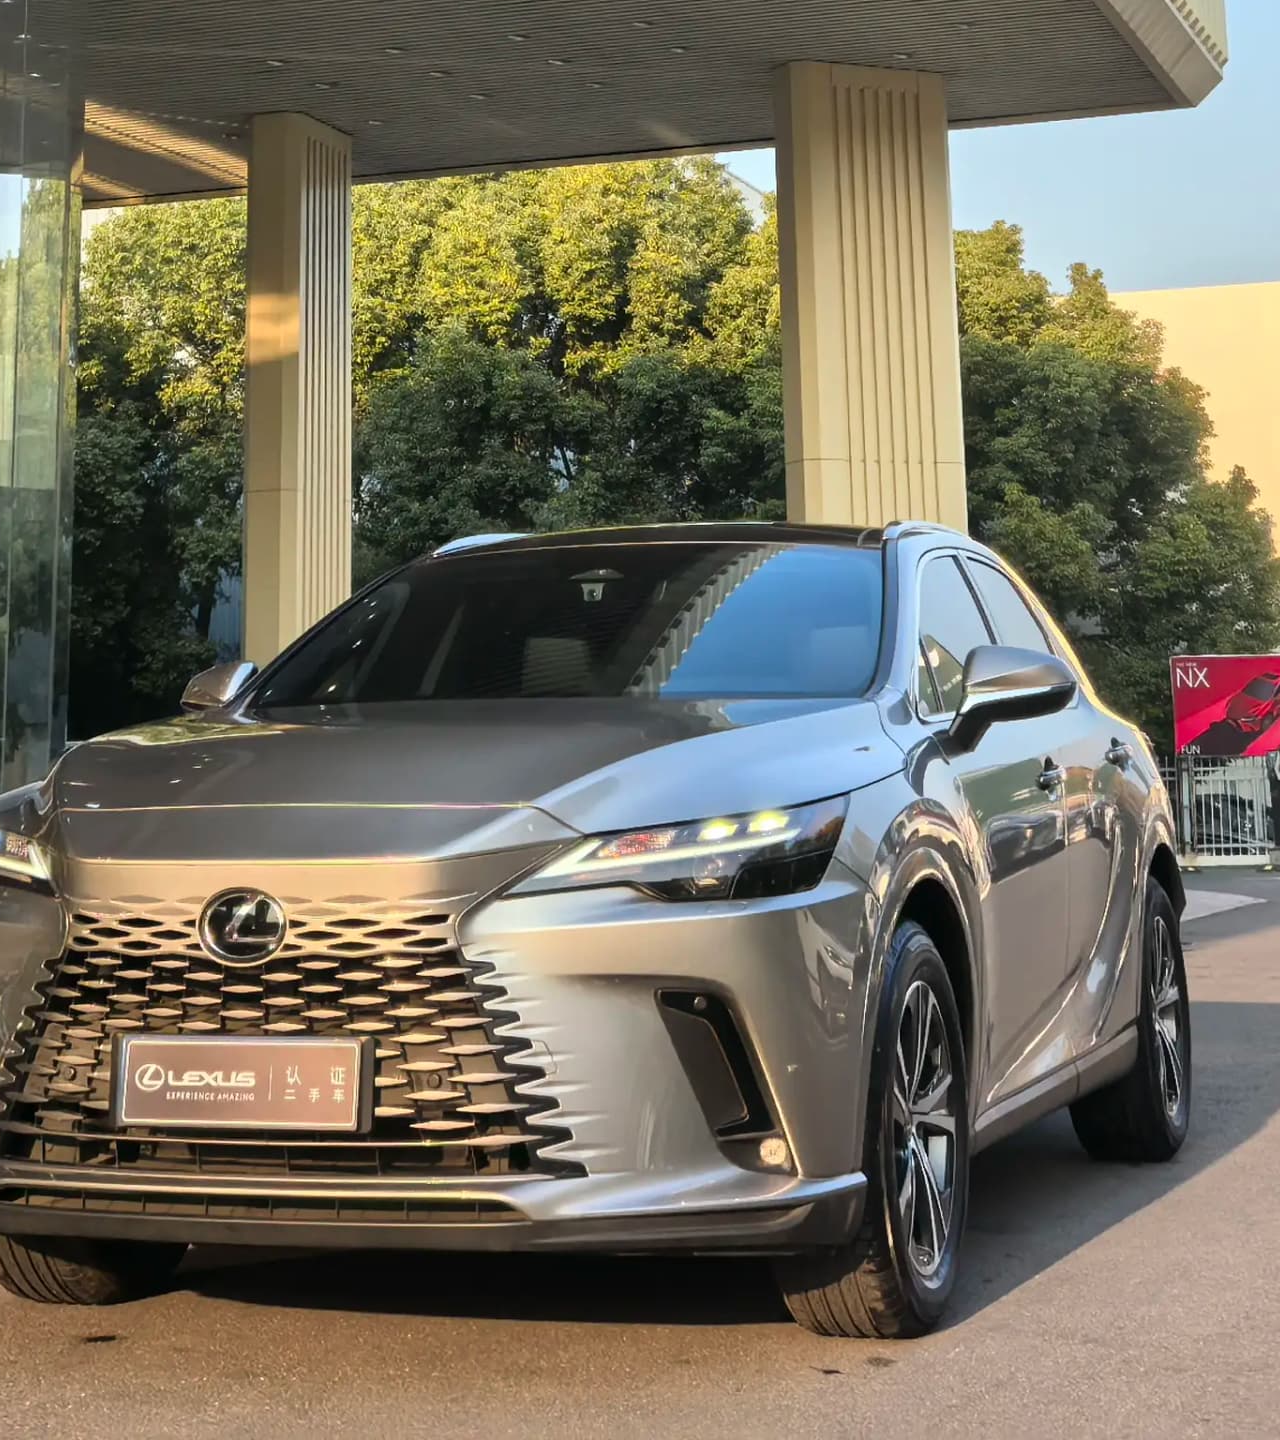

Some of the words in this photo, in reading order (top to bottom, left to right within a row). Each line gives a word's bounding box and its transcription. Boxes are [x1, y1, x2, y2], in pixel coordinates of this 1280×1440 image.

[1176, 667, 1210, 688] NX
[1181, 744, 1201, 755] FUN
[166, 1070, 257, 1088] LEXUS
[165, 1090, 215, 1102] EXPERIENCE
[216, 1091, 256, 1103] AMAZING
